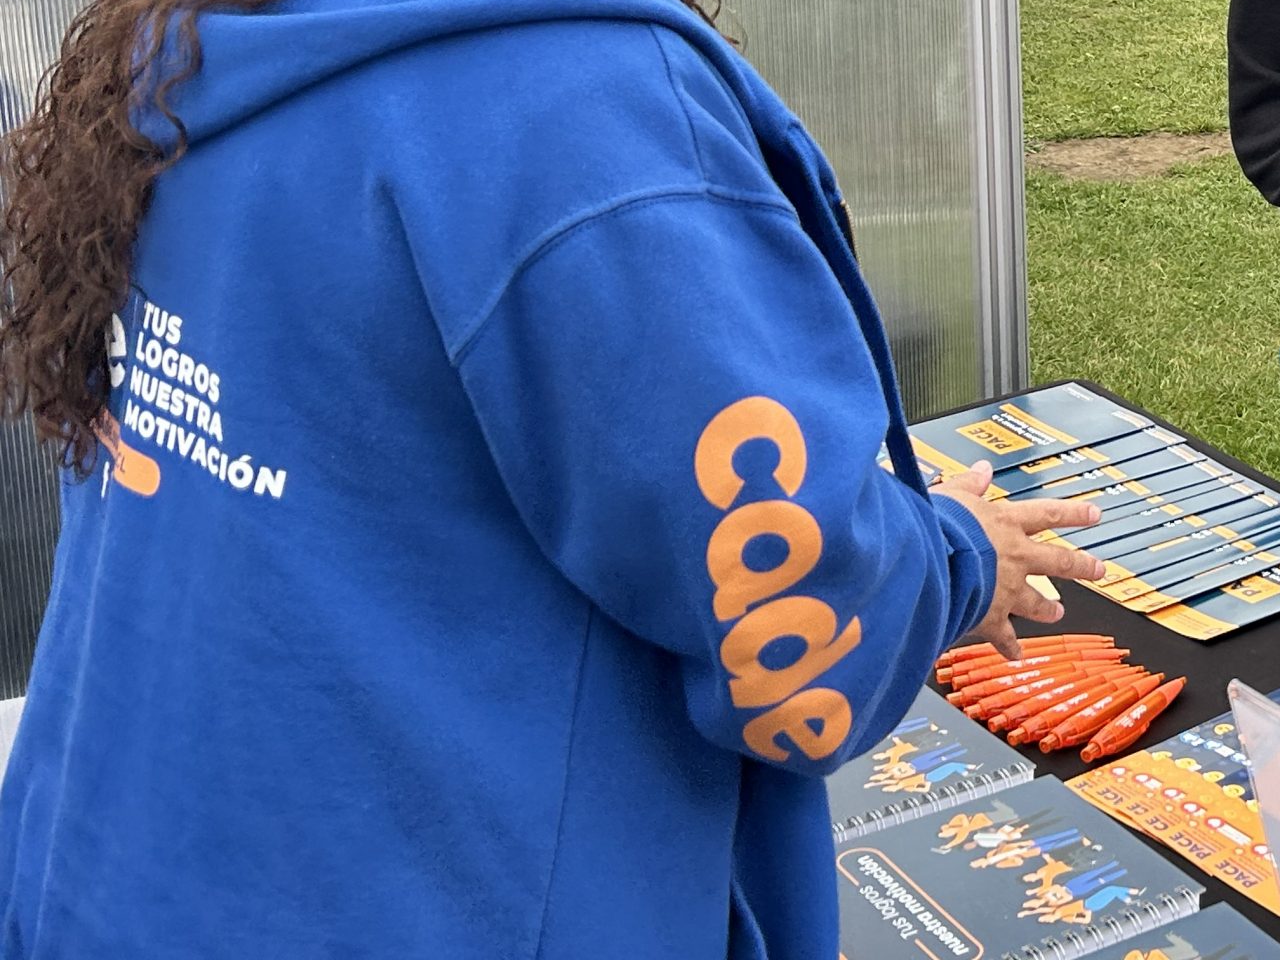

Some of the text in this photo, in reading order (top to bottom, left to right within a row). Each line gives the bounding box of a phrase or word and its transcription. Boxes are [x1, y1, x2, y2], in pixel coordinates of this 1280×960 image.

[143, 300, 183, 345] TUS
[135, 331, 221, 404] LOGROS
[130, 364, 224, 443] NUESTRA
[124, 398, 287, 499] MOTIVACIÓN
[968, 427, 1013, 450] PACE
[693, 395, 862, 762] cade
[1169, 831, 1213, 860] PACE
[1213, 859, 1259, 889] PACE
[857, 854, 970, 956] nuestra motivación
[859, 885, 919, 940] Tus logros
